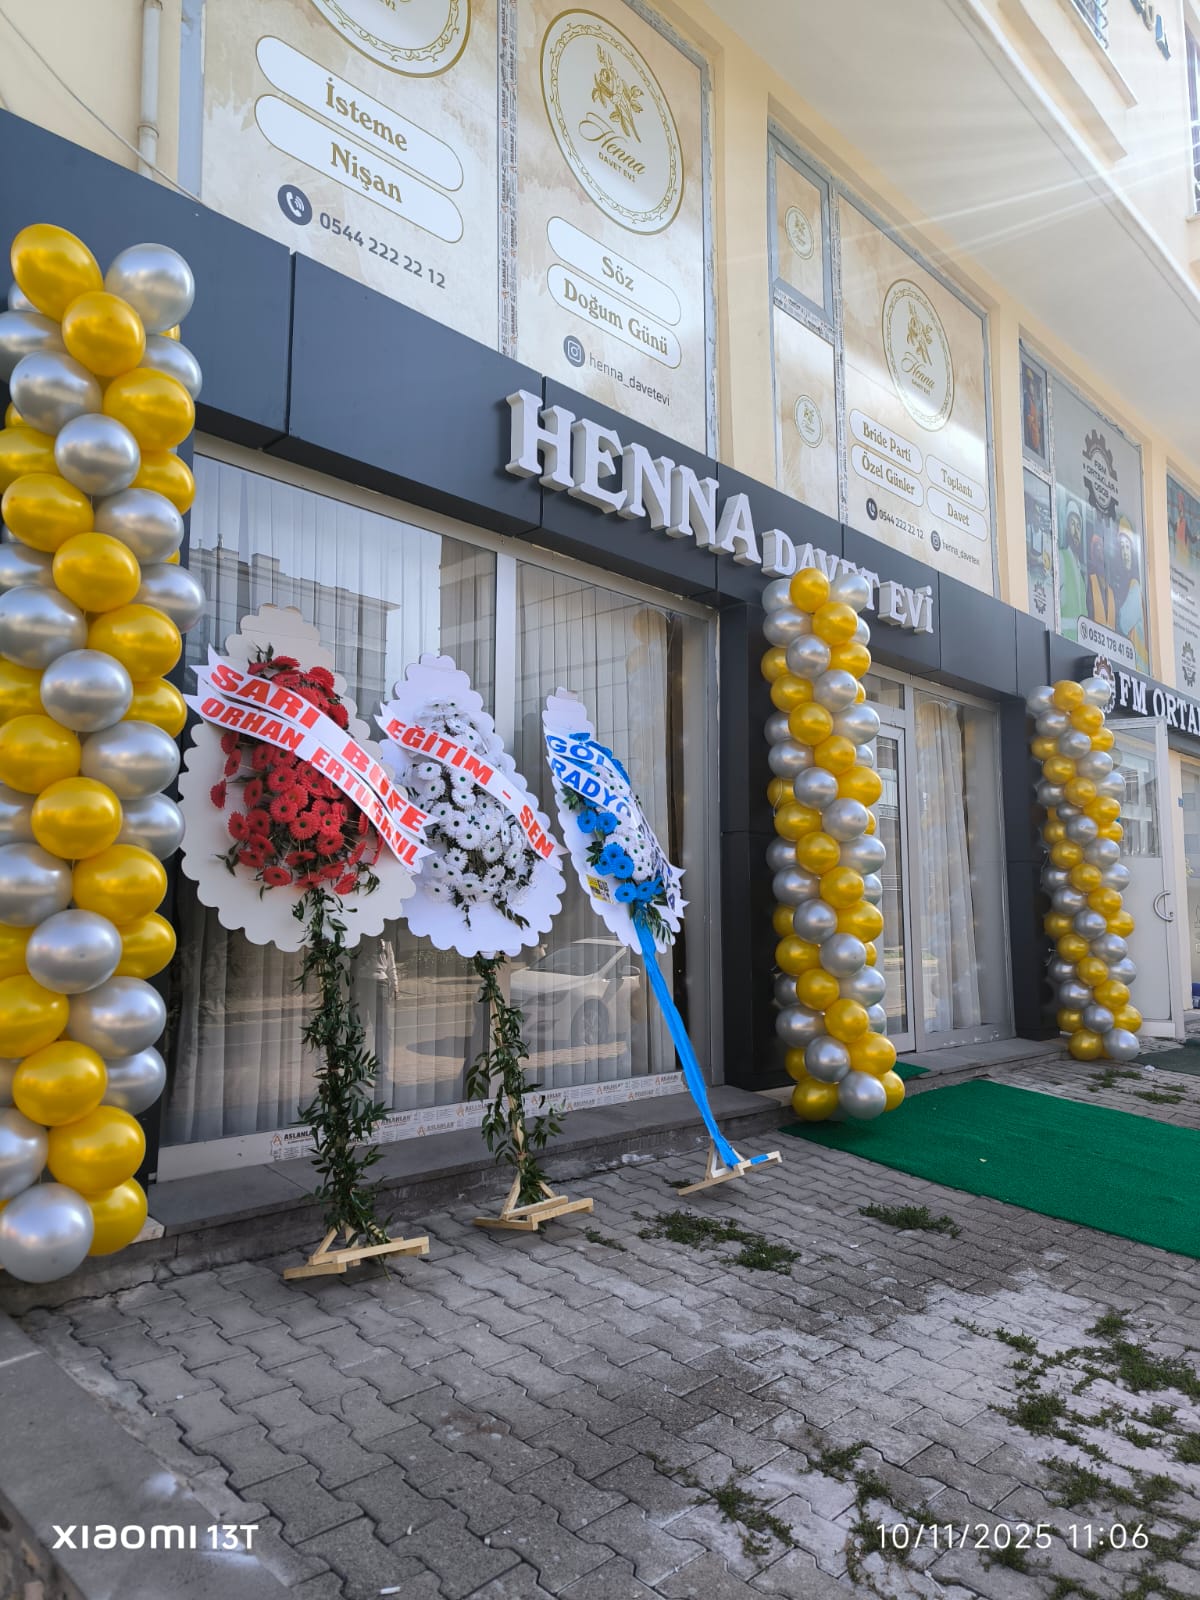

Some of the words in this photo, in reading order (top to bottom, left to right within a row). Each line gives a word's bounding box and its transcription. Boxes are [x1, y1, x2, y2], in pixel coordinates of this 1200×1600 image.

[325, 77, 408, 152] İsteme
[579, 112, 646, 175] Henna
[598, 151, 622, 173] DAVET
[330, 141, 403, 204] Nişan
[319, 212, 364, 248] 0544
[368, 236, 399, 266] 222
[403, 255, 423, 278] 22
[428, 268, 446, 289] 12
[602, 255, 634, 292] Söz
[563, 277, 624, 331] Doğum
[628, 317, 669, 356] Günü
[589, 351, 670, 406] henna_davetevi
[862, 421, 888, 449] Bride
[889, 438, 912, 463] Parti
[505, 388, 762, 566] HENNA
[861, 451, 884, 480] Özel
[885, 468, 915, 496] Günler
[940, 468, 974, 499] Toplantı
[878, 509, 895, 525] 0544
[916, 528, 924, 540] 12
[947, 502, 970, 527] Davet
[1088, 628, 1106, 647] 0532
[1106, 636, 1117, 653] 178
[211, 664, 321, 730] SARI
[1118, 670, 1149, 716] FM
[200, 697, 305, 752] ORHAN
[386, 718, 494, 786] EĞİTİM
[519, 804, 555, 859] SEN
